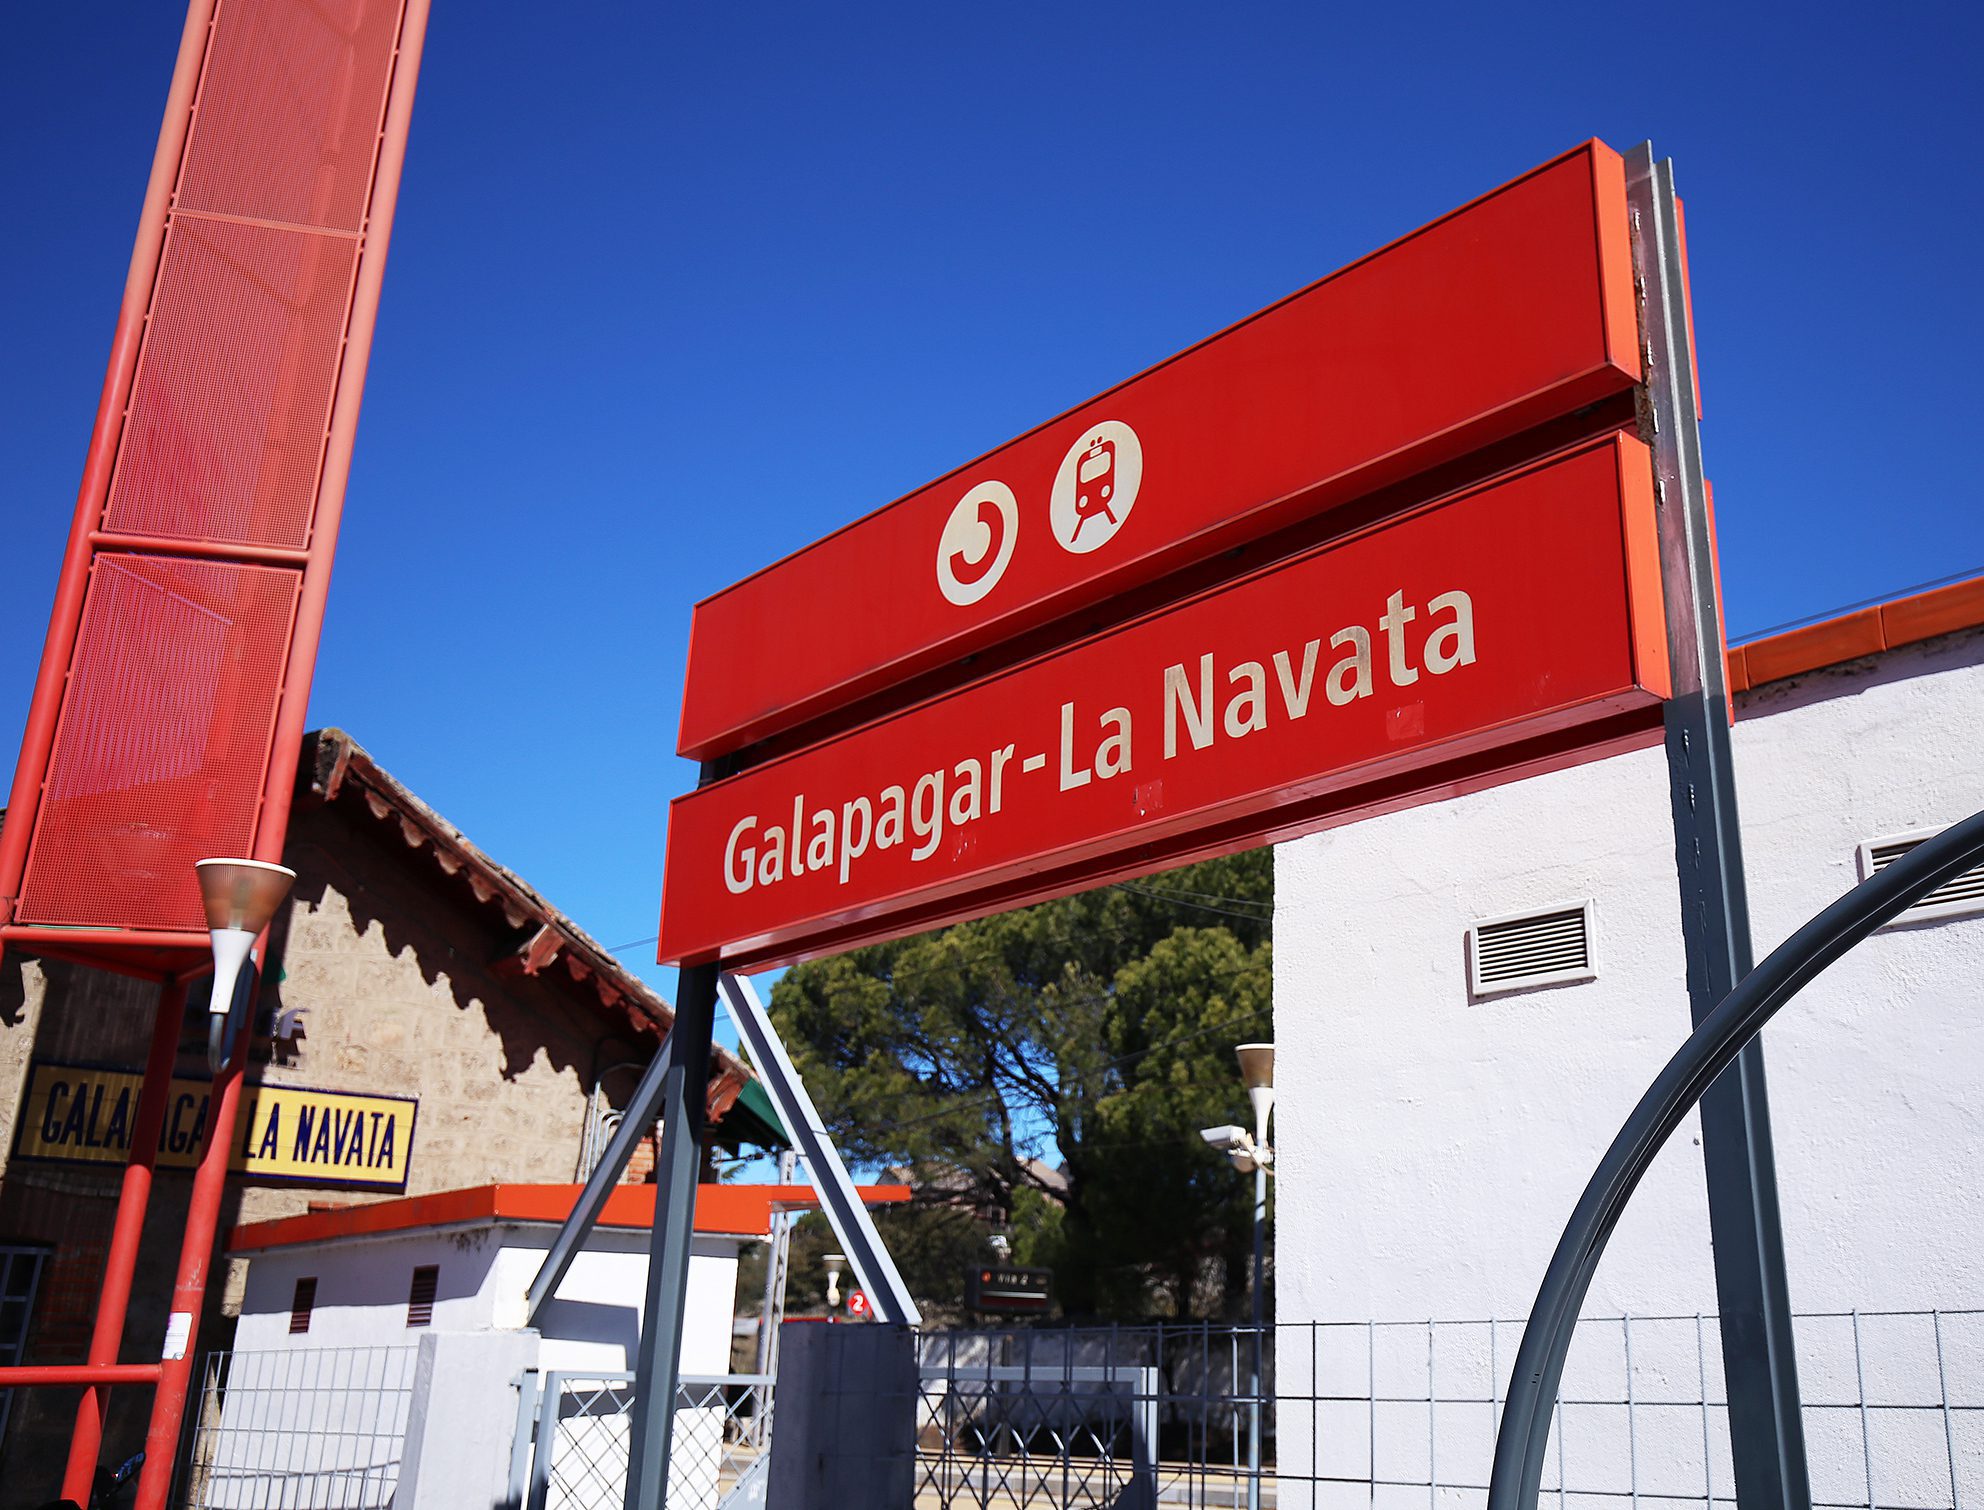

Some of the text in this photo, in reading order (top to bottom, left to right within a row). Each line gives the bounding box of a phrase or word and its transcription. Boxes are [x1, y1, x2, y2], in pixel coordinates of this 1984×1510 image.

[724, 589, 1477, 895] Galapagar-La Navata
[242, 1100, 281, 1160] LA
[292, 1104, 396, 1169] NAVATA
[853, 1294, 864, 1312] 2
